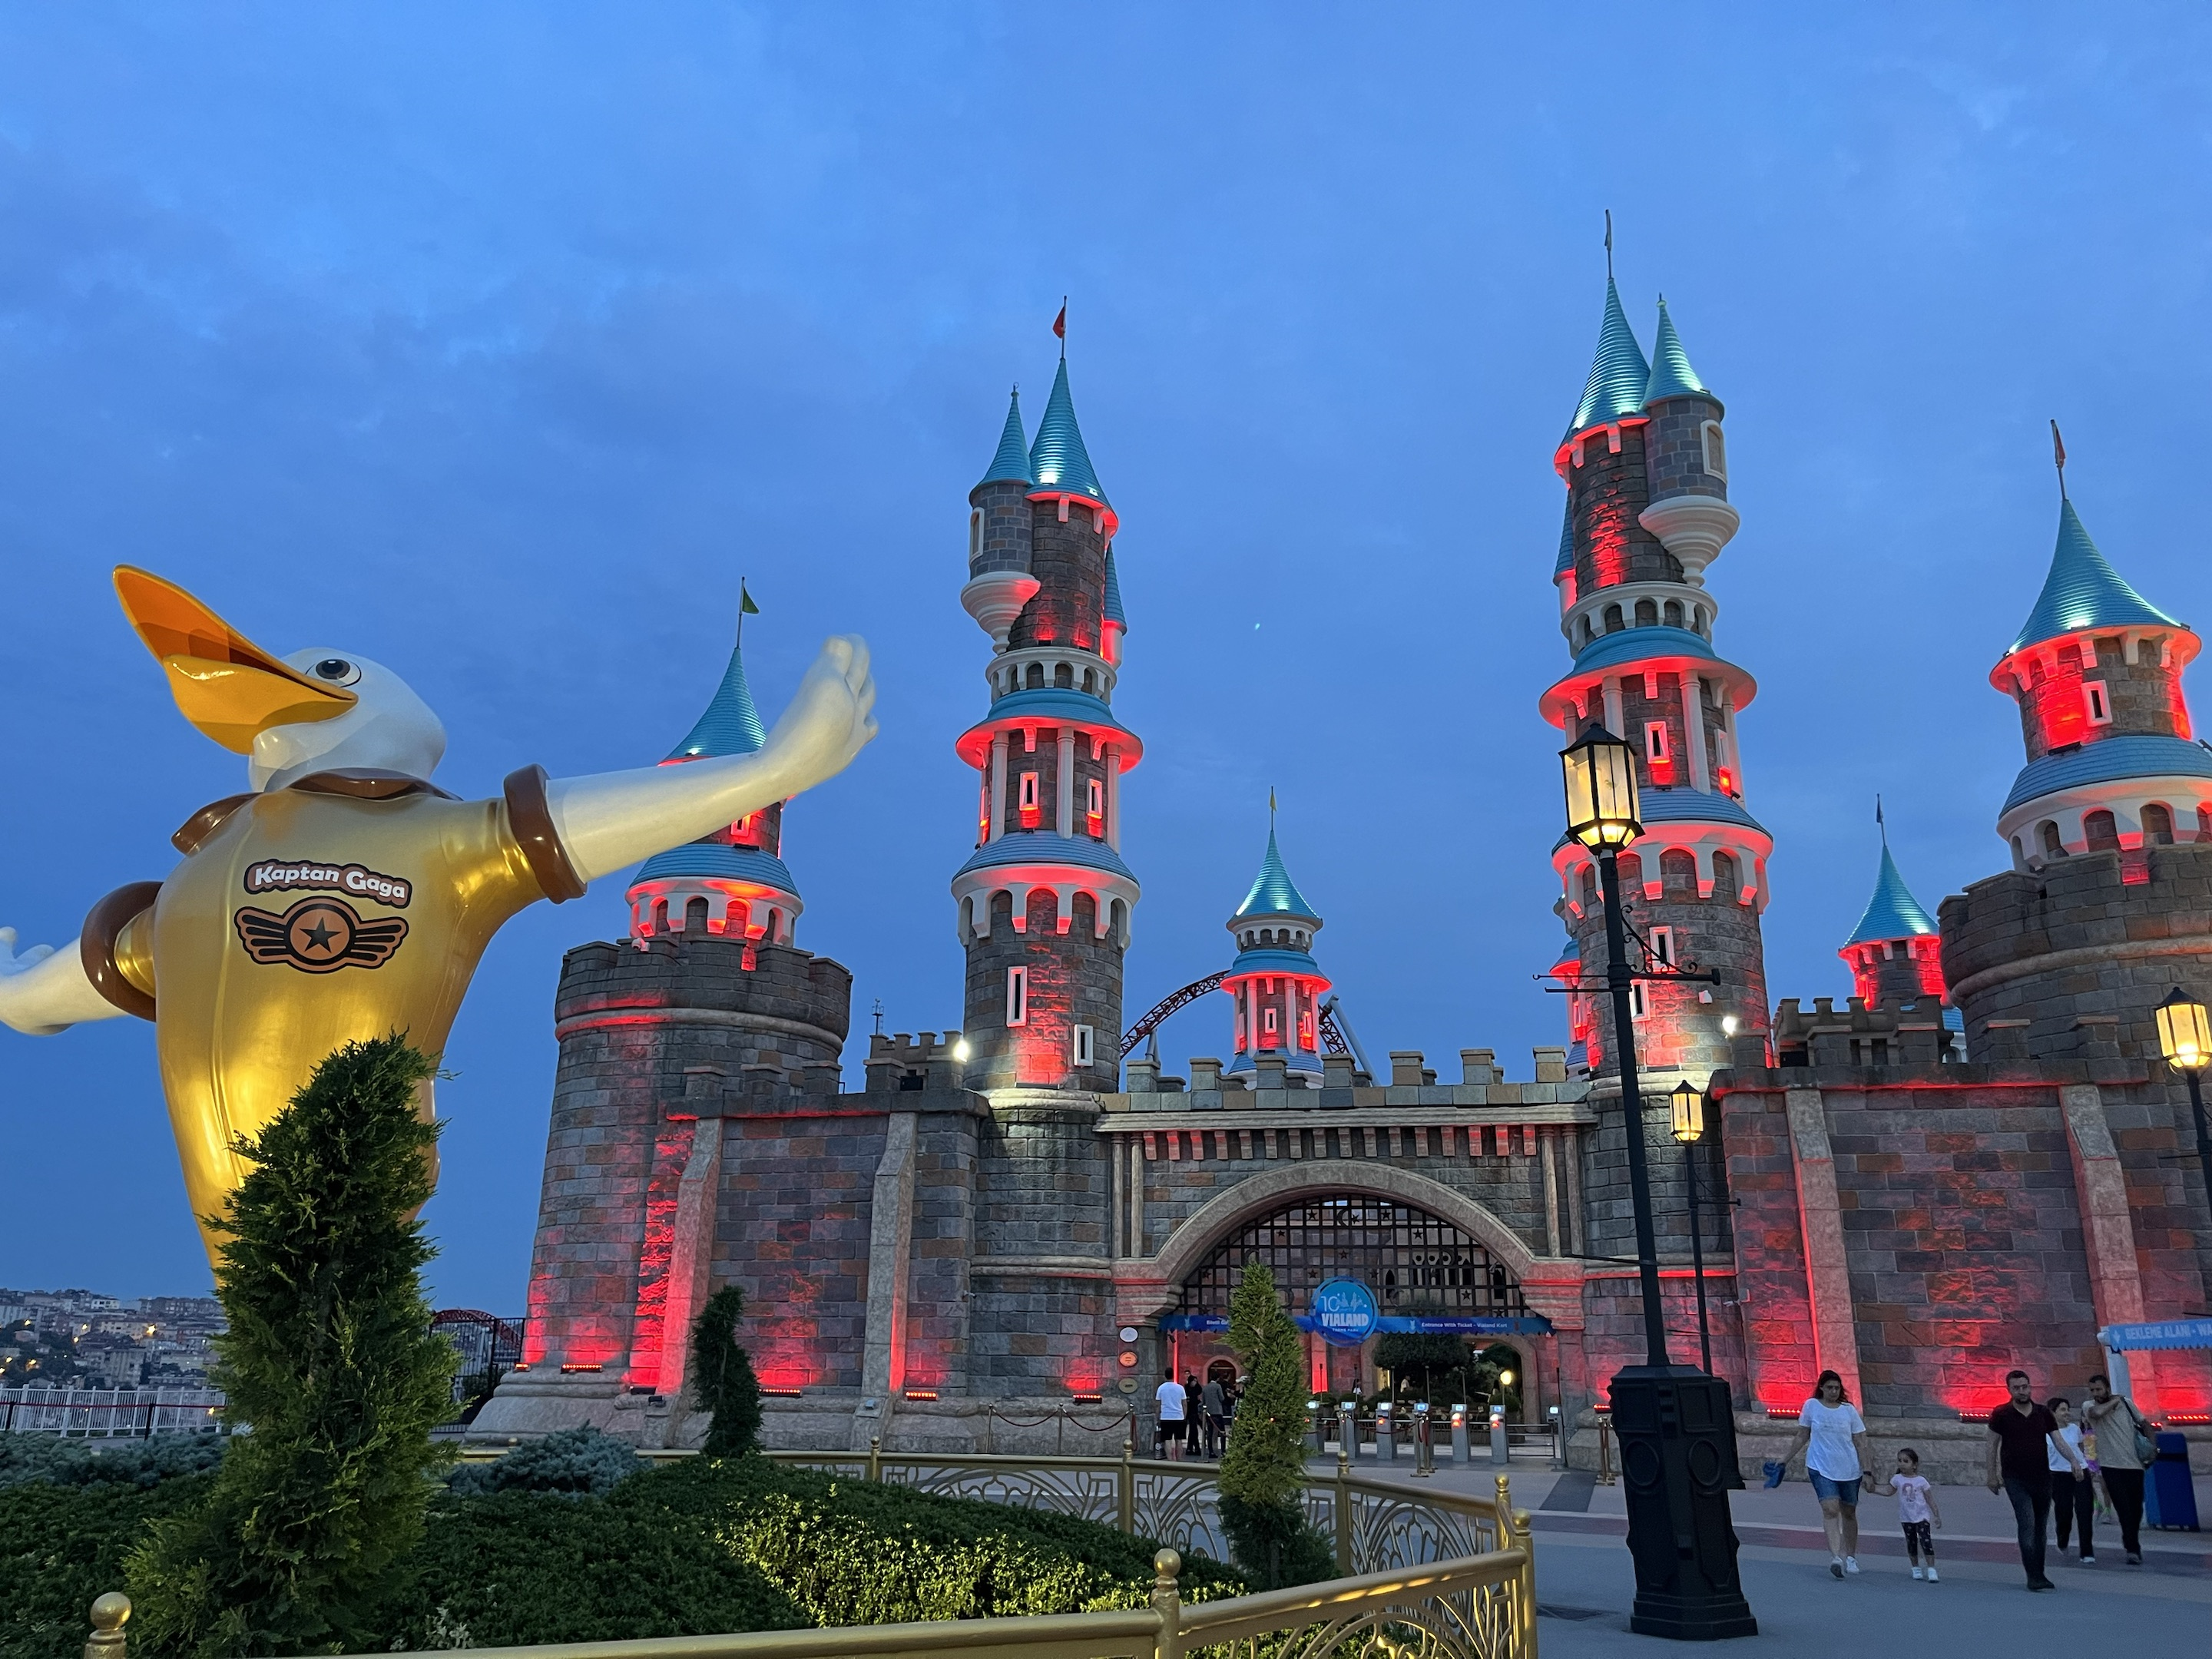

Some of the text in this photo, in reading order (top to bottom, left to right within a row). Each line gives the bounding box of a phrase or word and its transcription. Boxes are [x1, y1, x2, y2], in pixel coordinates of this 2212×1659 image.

[255, 866, 405, 898] Kaptan Gaga
[1321, 1313, 1369, 1326] VIALAND
[2124, 1326, 2163, 1339] BEKLEME
[2164, 1325, 2191, 1337] ALANI
